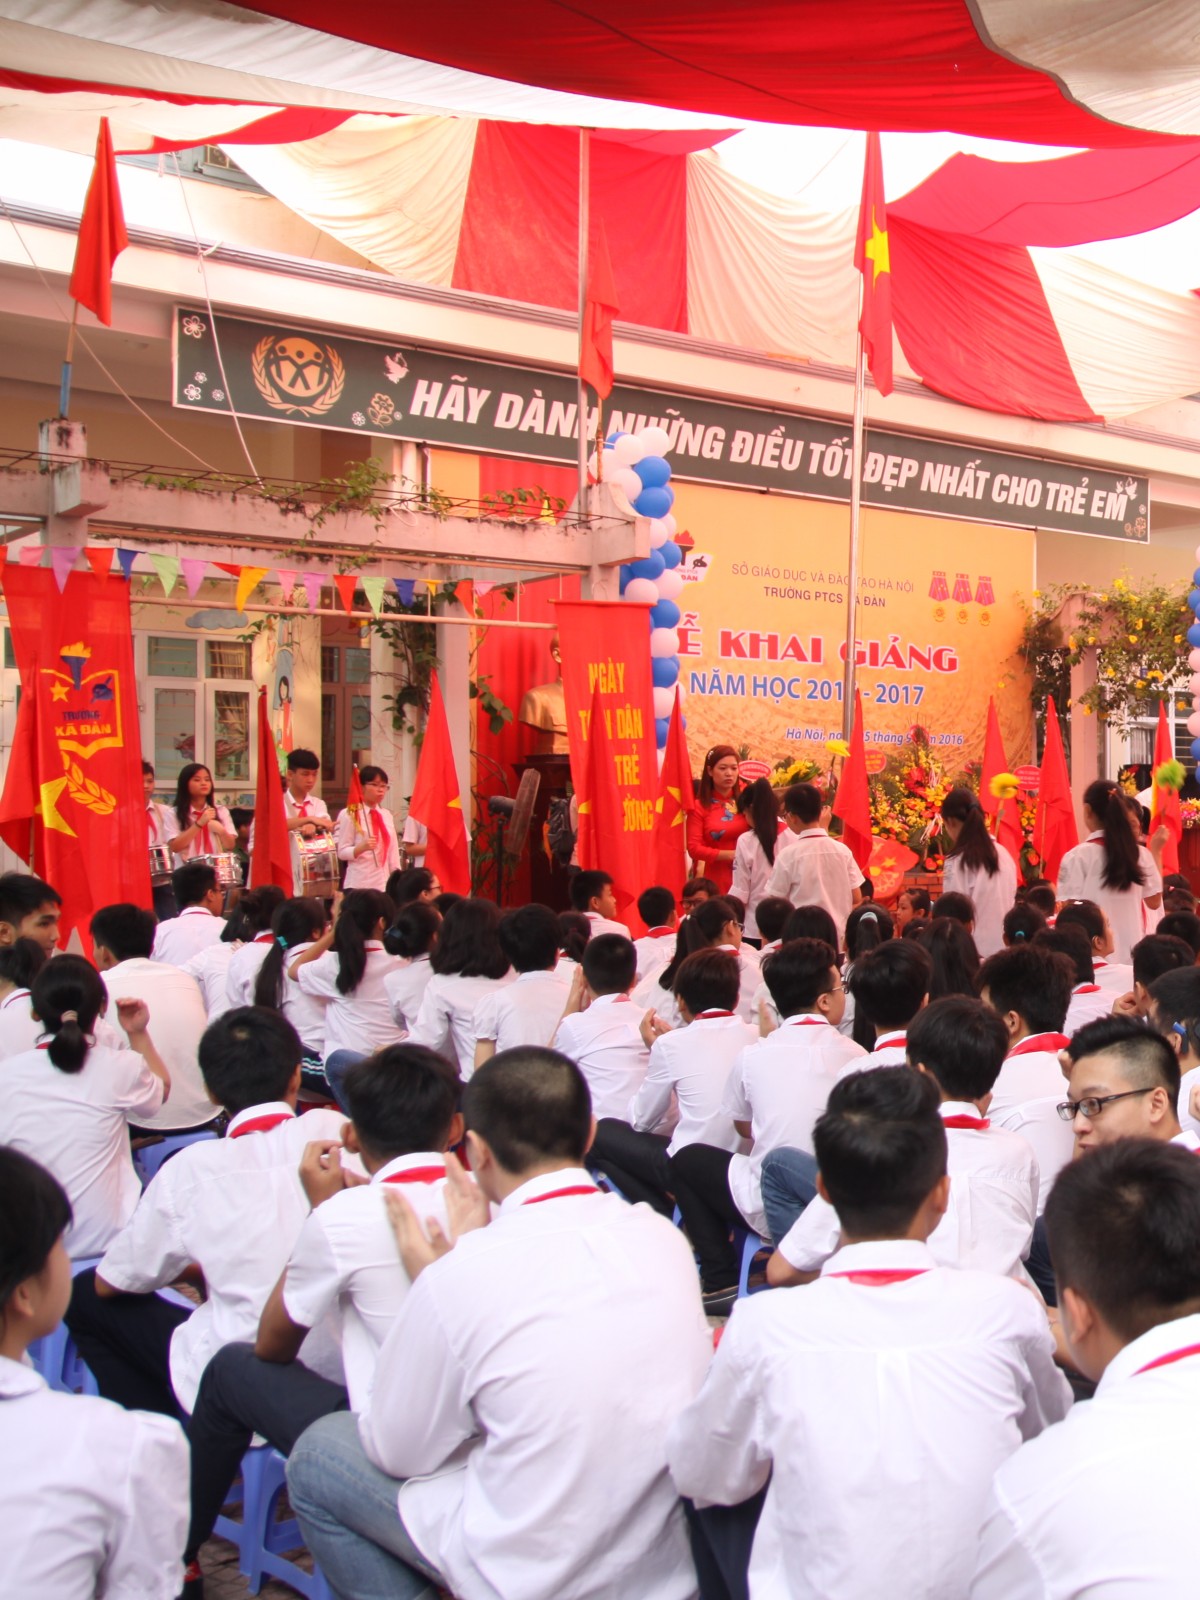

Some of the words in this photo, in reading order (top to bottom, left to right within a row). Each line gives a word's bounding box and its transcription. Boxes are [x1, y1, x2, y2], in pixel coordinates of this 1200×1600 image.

[409, 374, 491, 424] HÃY
[729, 425, 804, 471] ĐIỀU
[863, 451, 919, 492] ĐẸP
[920, 459, 990, 500] NHẤT
[991, 473, 1042, 508] CHO
[1046, 476, 1089, 515] TRẺ
[1090, 490, 1128, 521] EM
[731, 561, 749, 576] SỞ
[751, 564, 780, 580] GIÁO
[783, 568, 807, 583] DỤC
[810, 571, 825, 584] VÀ
[879, 578, 893, 591] HÀ
[896, 579, 914, 594] NỘI
[764, 586, 811, 601] TRƯỜNG
[814, 591, 843, 604] PTCS
[863, 594, 886, 608] ĐÀN
[677, 613, 701, 656] Ễ
[720, 630, 822, 664] KHAI
[839, 636, 959, 673] GIẢNG
[588, 657, 625, 693] NGÀY
[690, 669, 745, 697] NĂM
[752, 676, 801, 704] HỌC
[807, 680, 857, 701] 201
[875, 683, 925, 705] 2017
[616, 703, 644, 740] DÂN
[786, 727, 801, 740] Hà
[873, 732, 904, 746] tháng
[938, 734, 963, 745] 2016
[614, 744, 641, 785] TRẺ
